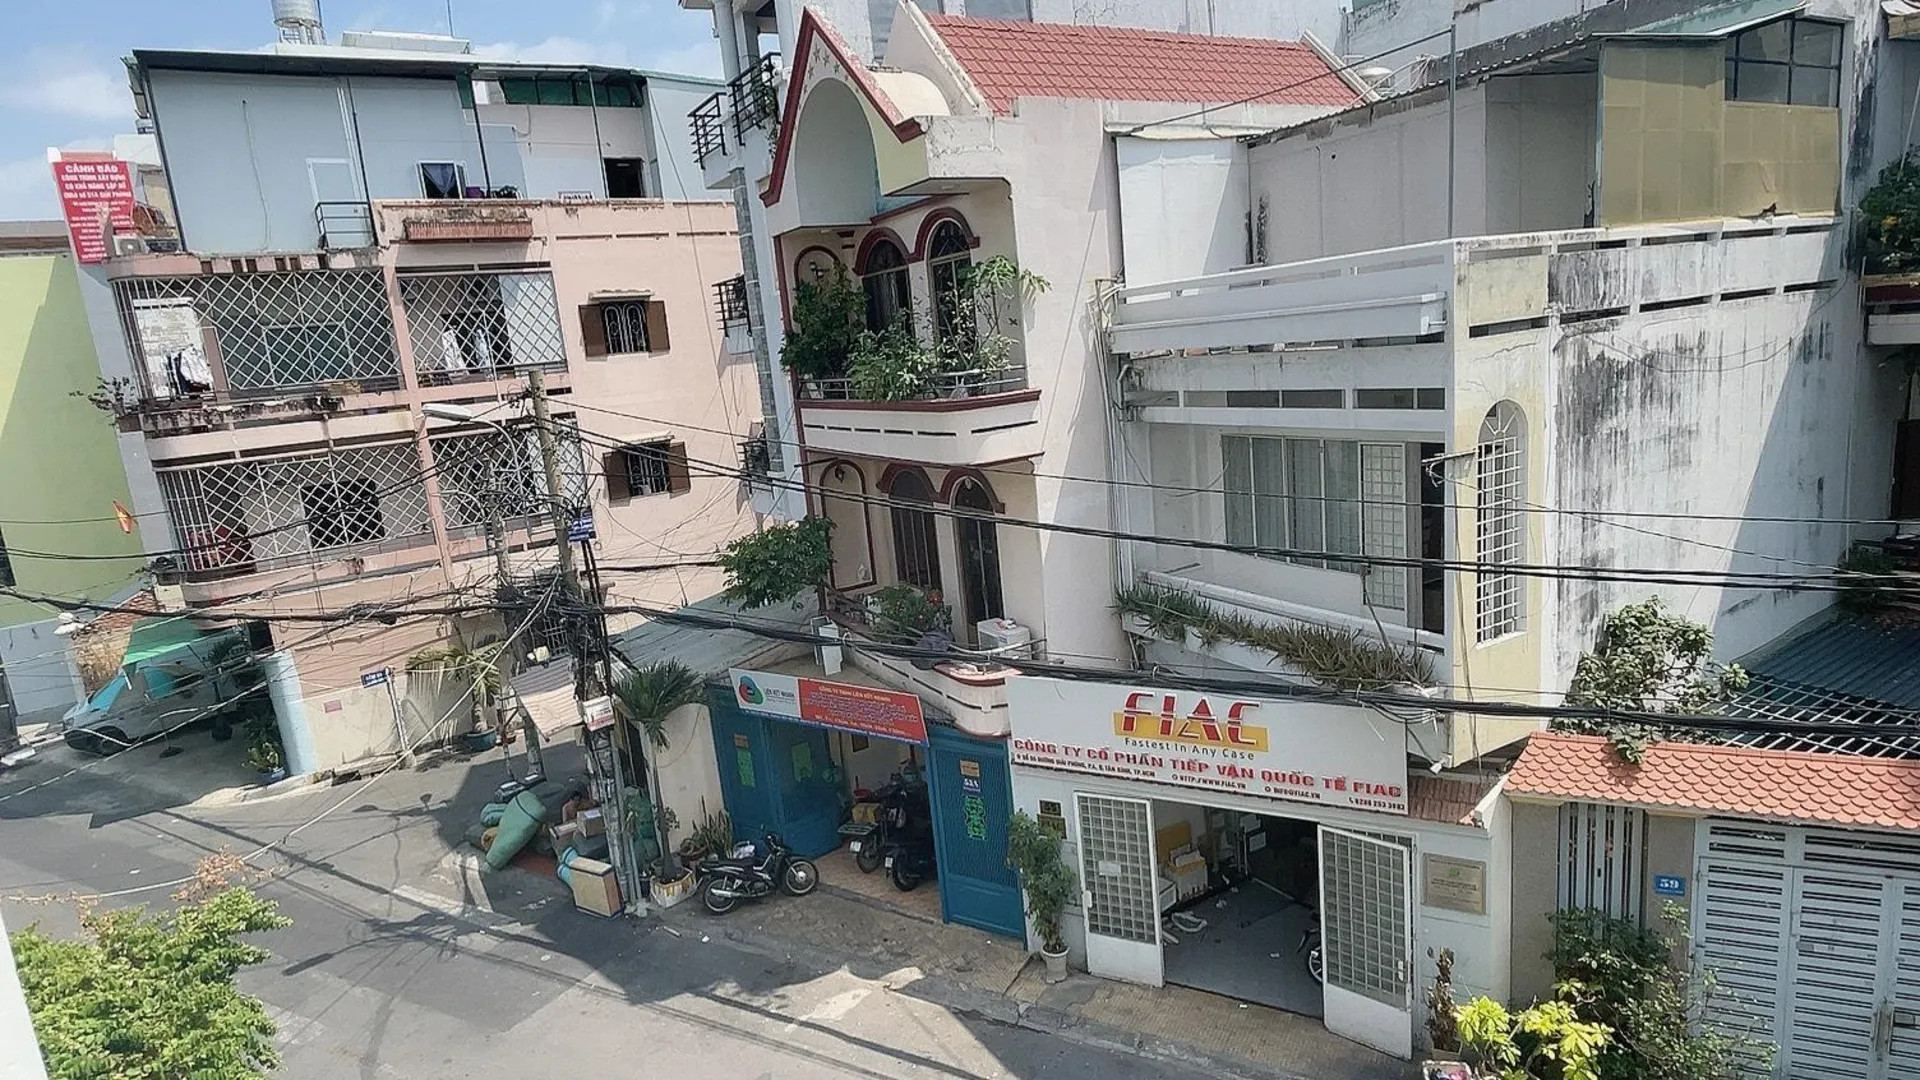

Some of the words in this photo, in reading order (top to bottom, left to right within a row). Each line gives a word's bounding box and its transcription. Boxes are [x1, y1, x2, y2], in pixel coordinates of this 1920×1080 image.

[65, 162, 95, 173] CẢNH
[96, 163, 118, 173] BÁO
[1122, 691, 1261, 745] FIAC
[1125, 737, 1168, 750] Fastest
[1175, 742, 1186, 753] In
[1192, 744, 1216, 758] Any
[1223, 748, 1254, 760] Case
[1014, 739, 1057, 754] CÔNG
[1062, 745, 1081, 757] TY
[1170, 758, 1208, 773] TIẾP
[1217, 764, 1254, 779] VẬN
[1261, 770, 1314, 786] QUỐC
[1322, 776, 1347, 791] TẾ
[1353, 781, 1401, 797] FIAC
[1660, 878, 1679, 888] 59
